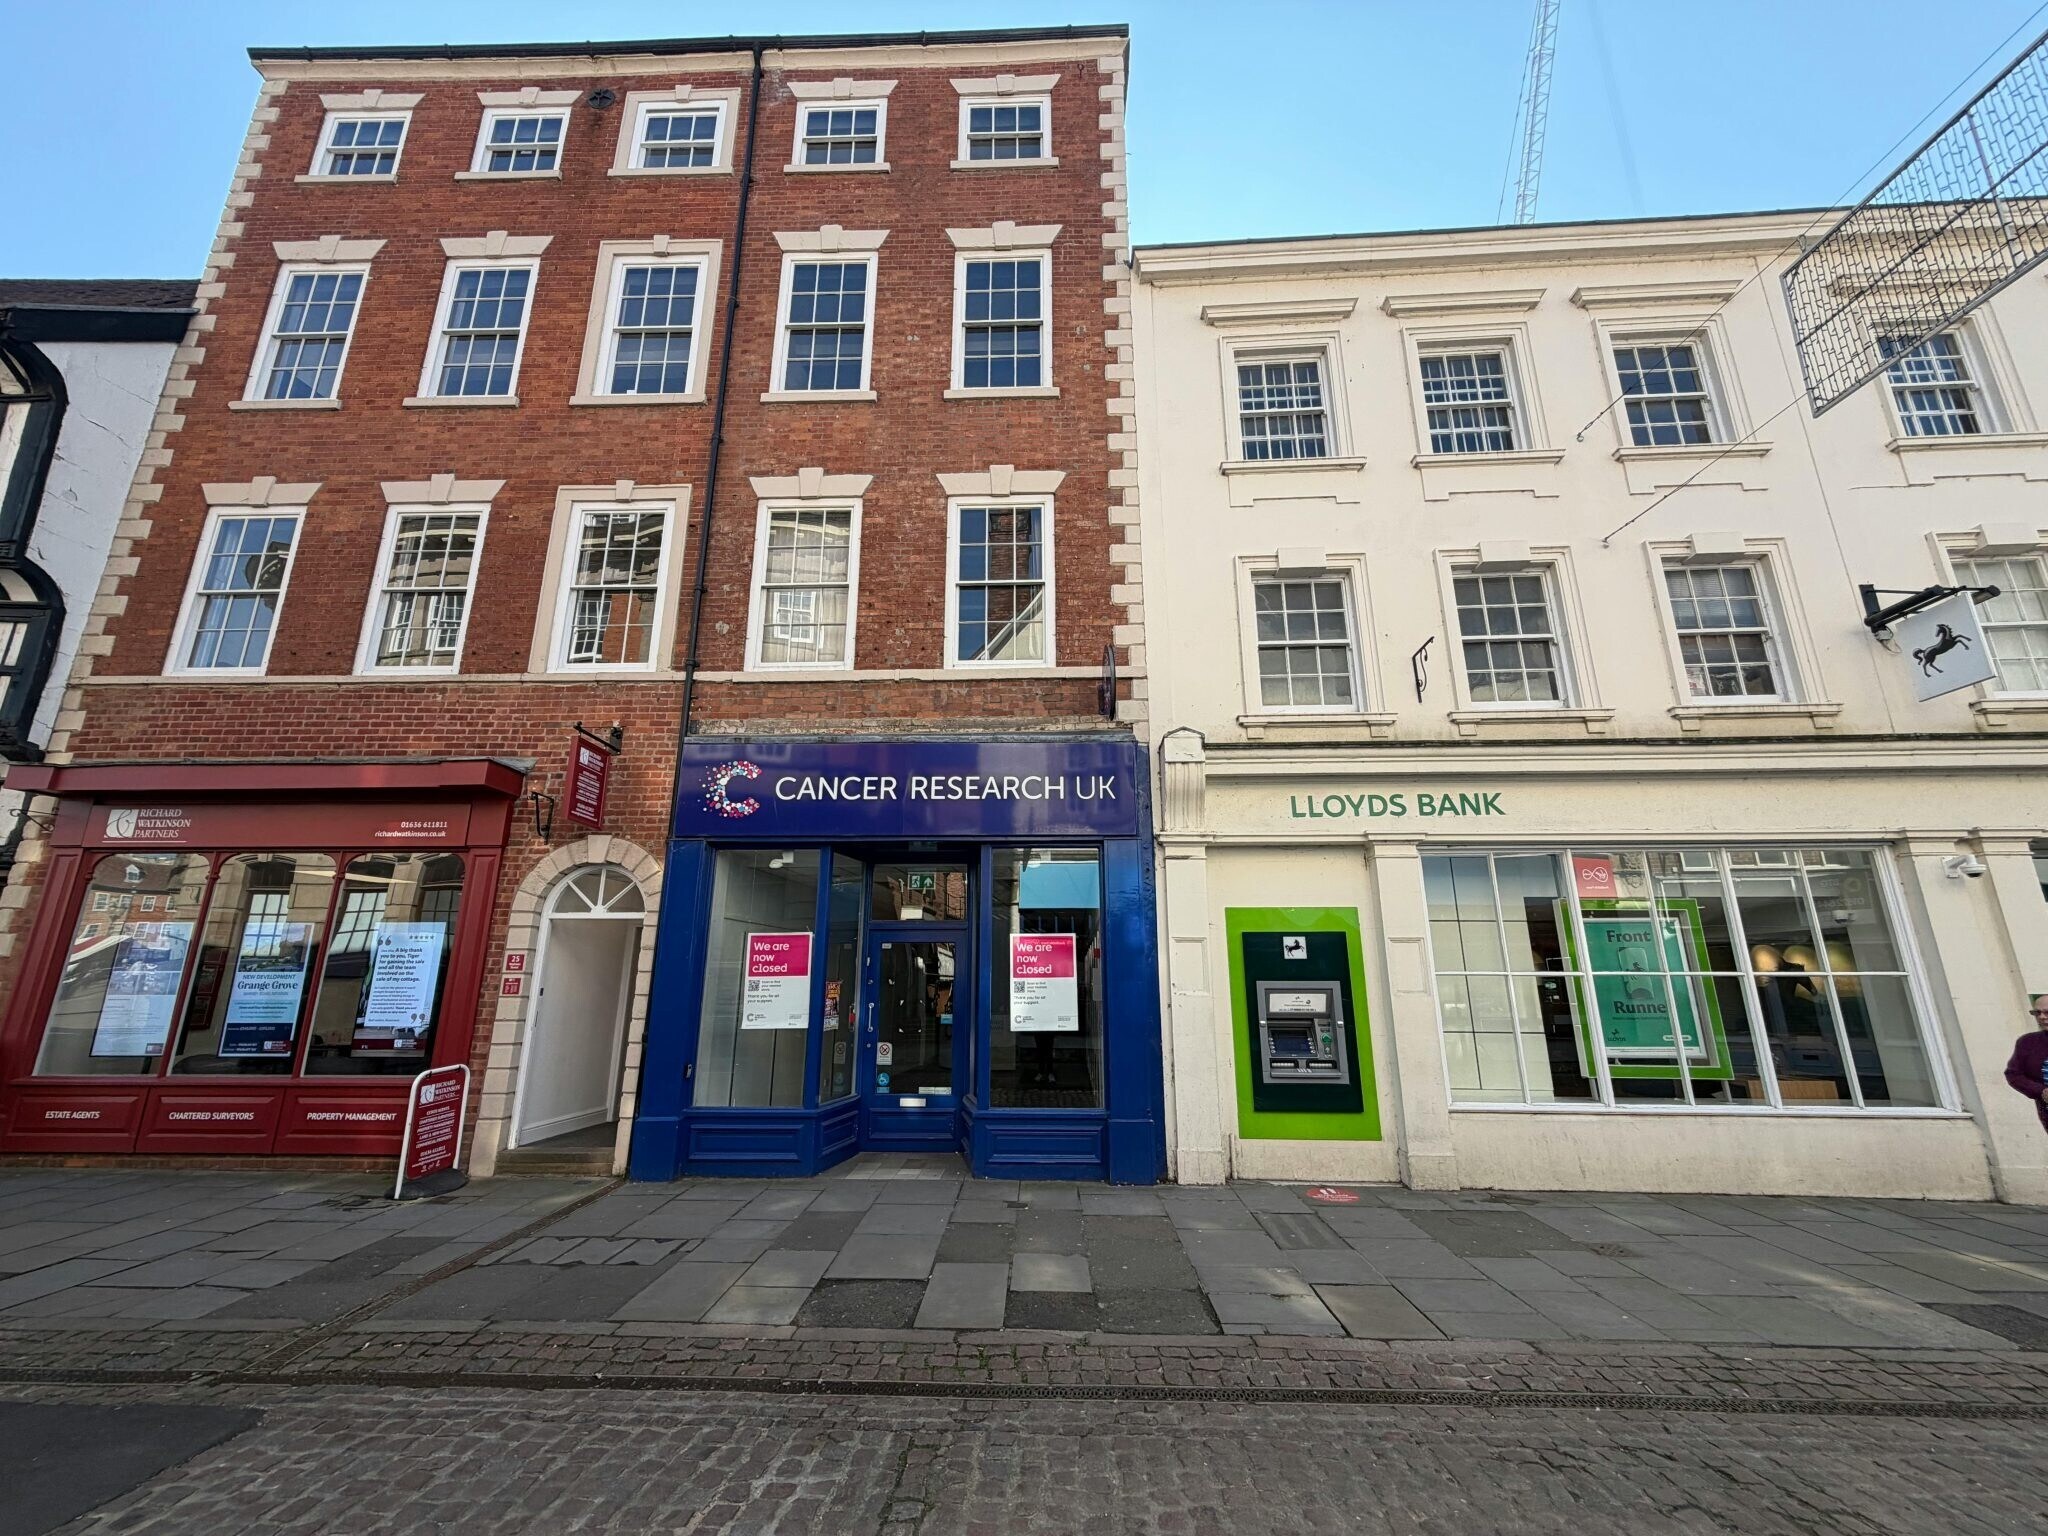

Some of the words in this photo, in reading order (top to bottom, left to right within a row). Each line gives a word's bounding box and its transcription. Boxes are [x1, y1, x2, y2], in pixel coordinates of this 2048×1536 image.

[775, 776, 898, 800] CANCER
[910, 775, 1065, 800] RESEARCH
[1076, 775, 1117, 800] UK
[1290, 793, 1408, 818] LLOYDS
[1416, 792, 1507, 817] BANK
[139, 808, 182, 817] RICHARD
[137, 818, 192, 828] WATKINSON
[134, 829, 180, 838] PARTNERS
[374, 830, 447, 838] richardwatkinson.co.uk
[1606, 929, 1651, 943] Front
[753, 942, 771, 951] We
[772, 943, 790, 951] are
[1016, 943, 1033, 952] We
[1034, 944, 1052, 952] are
[752, 954, 775, 962] now
[1016, 955, 1038, 963] now
[751, 963, 788, 973] closed
[1016, 964, 1052, 974] closed
[237, 981, 270, 990] Grange
[271, 981, 298, 989] Grove
[1613, 1000, 1668, 1014] Runne
[45, 1111, 71, 1119] ESTATE
[71, 1111, 100, 1119] AGENTS
[168, 1112, 211, 1120] CHARTERED
[211, 1112, 255, 1120] SURVEYORS
[306, 1112, 344, 1120] PROPERTY
